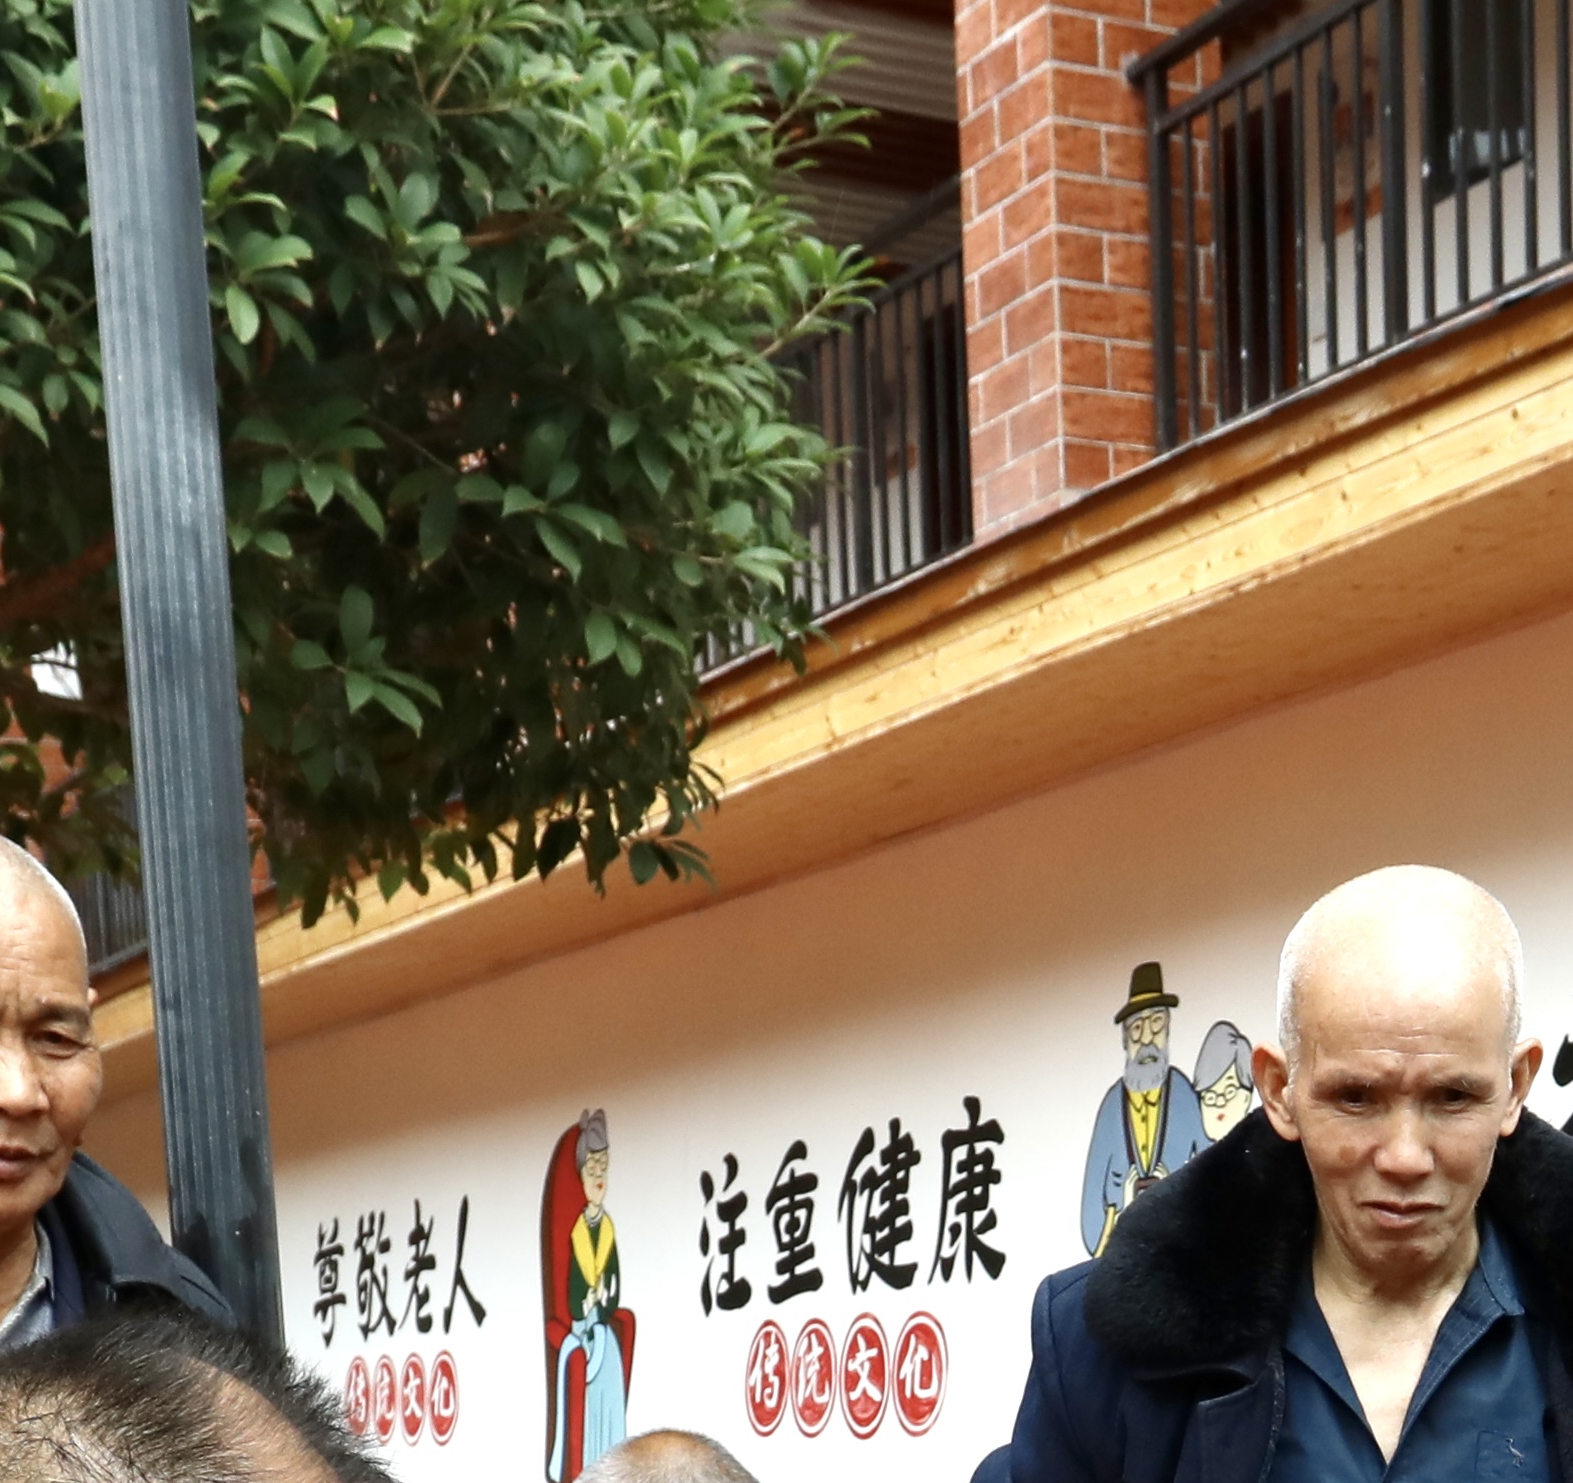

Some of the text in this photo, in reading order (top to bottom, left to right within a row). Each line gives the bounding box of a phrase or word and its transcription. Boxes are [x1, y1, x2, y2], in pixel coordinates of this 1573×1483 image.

[313, 1194, 487, 1349] 尊敬老人
[699, 1094, 1007, 1318] 注重健康
[747, 1326, 941, 1411] 传统文化
